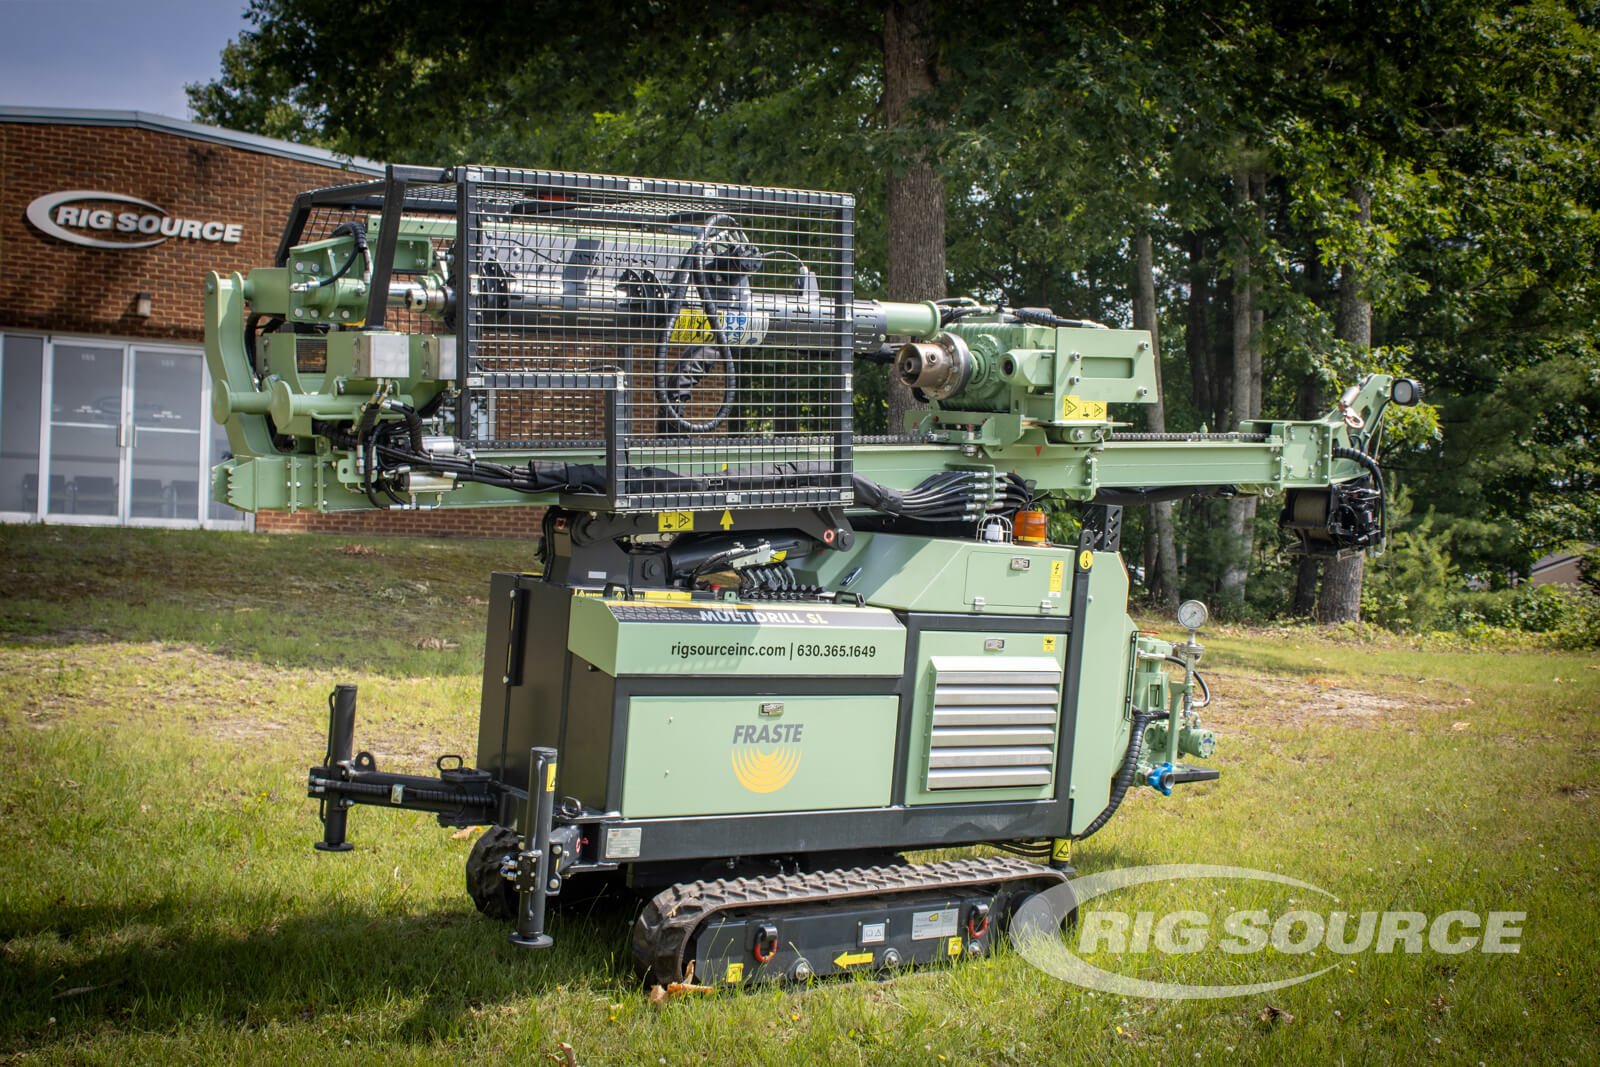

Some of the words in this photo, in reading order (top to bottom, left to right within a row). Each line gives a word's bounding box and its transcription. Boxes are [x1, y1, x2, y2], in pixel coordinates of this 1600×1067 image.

[56, 206, 114, 230] RIG
[116, 212, 244, 243] SOURCE
[699, 610, 805, 624] MULTIDRILL
[806, 613, 829, 625] SL
[671, 641, 786, 659] rigsourceinc.com
[797, 644, 876, 658] 630.365.1649
[733, 723, 804, 744] FRASTE
